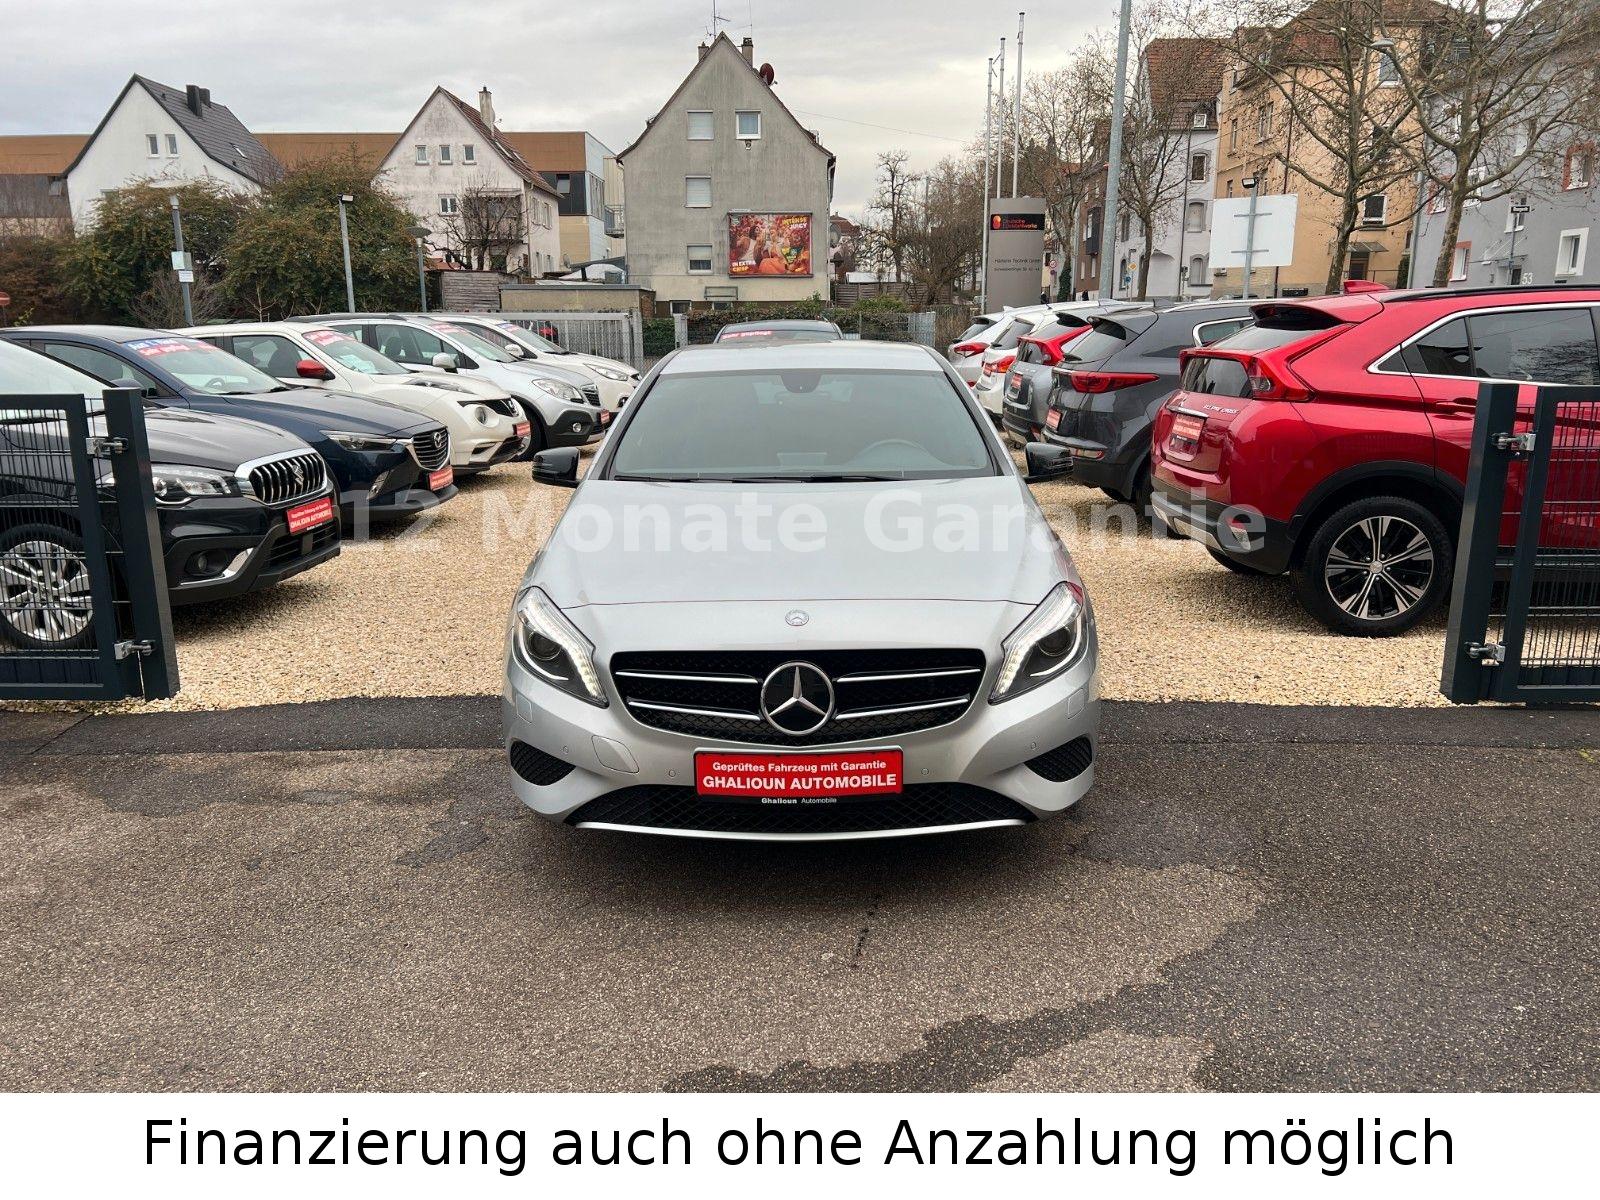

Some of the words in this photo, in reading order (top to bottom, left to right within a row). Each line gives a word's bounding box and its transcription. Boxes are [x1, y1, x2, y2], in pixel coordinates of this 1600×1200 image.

[1521, 272, 1533, 285] 53
[712, 761, 766, 773] Geprüftes
[767, 762, 818, 774] Fahrzeug
[820, 761, 838, 772] mit
[841, 760, 887, 771] Garantie
[702, 775, 786, 790] GHALIOUN
[789, 773, 897, 790] AUTOMOBILE
[760, 797, 798, 805] Ghalioun
